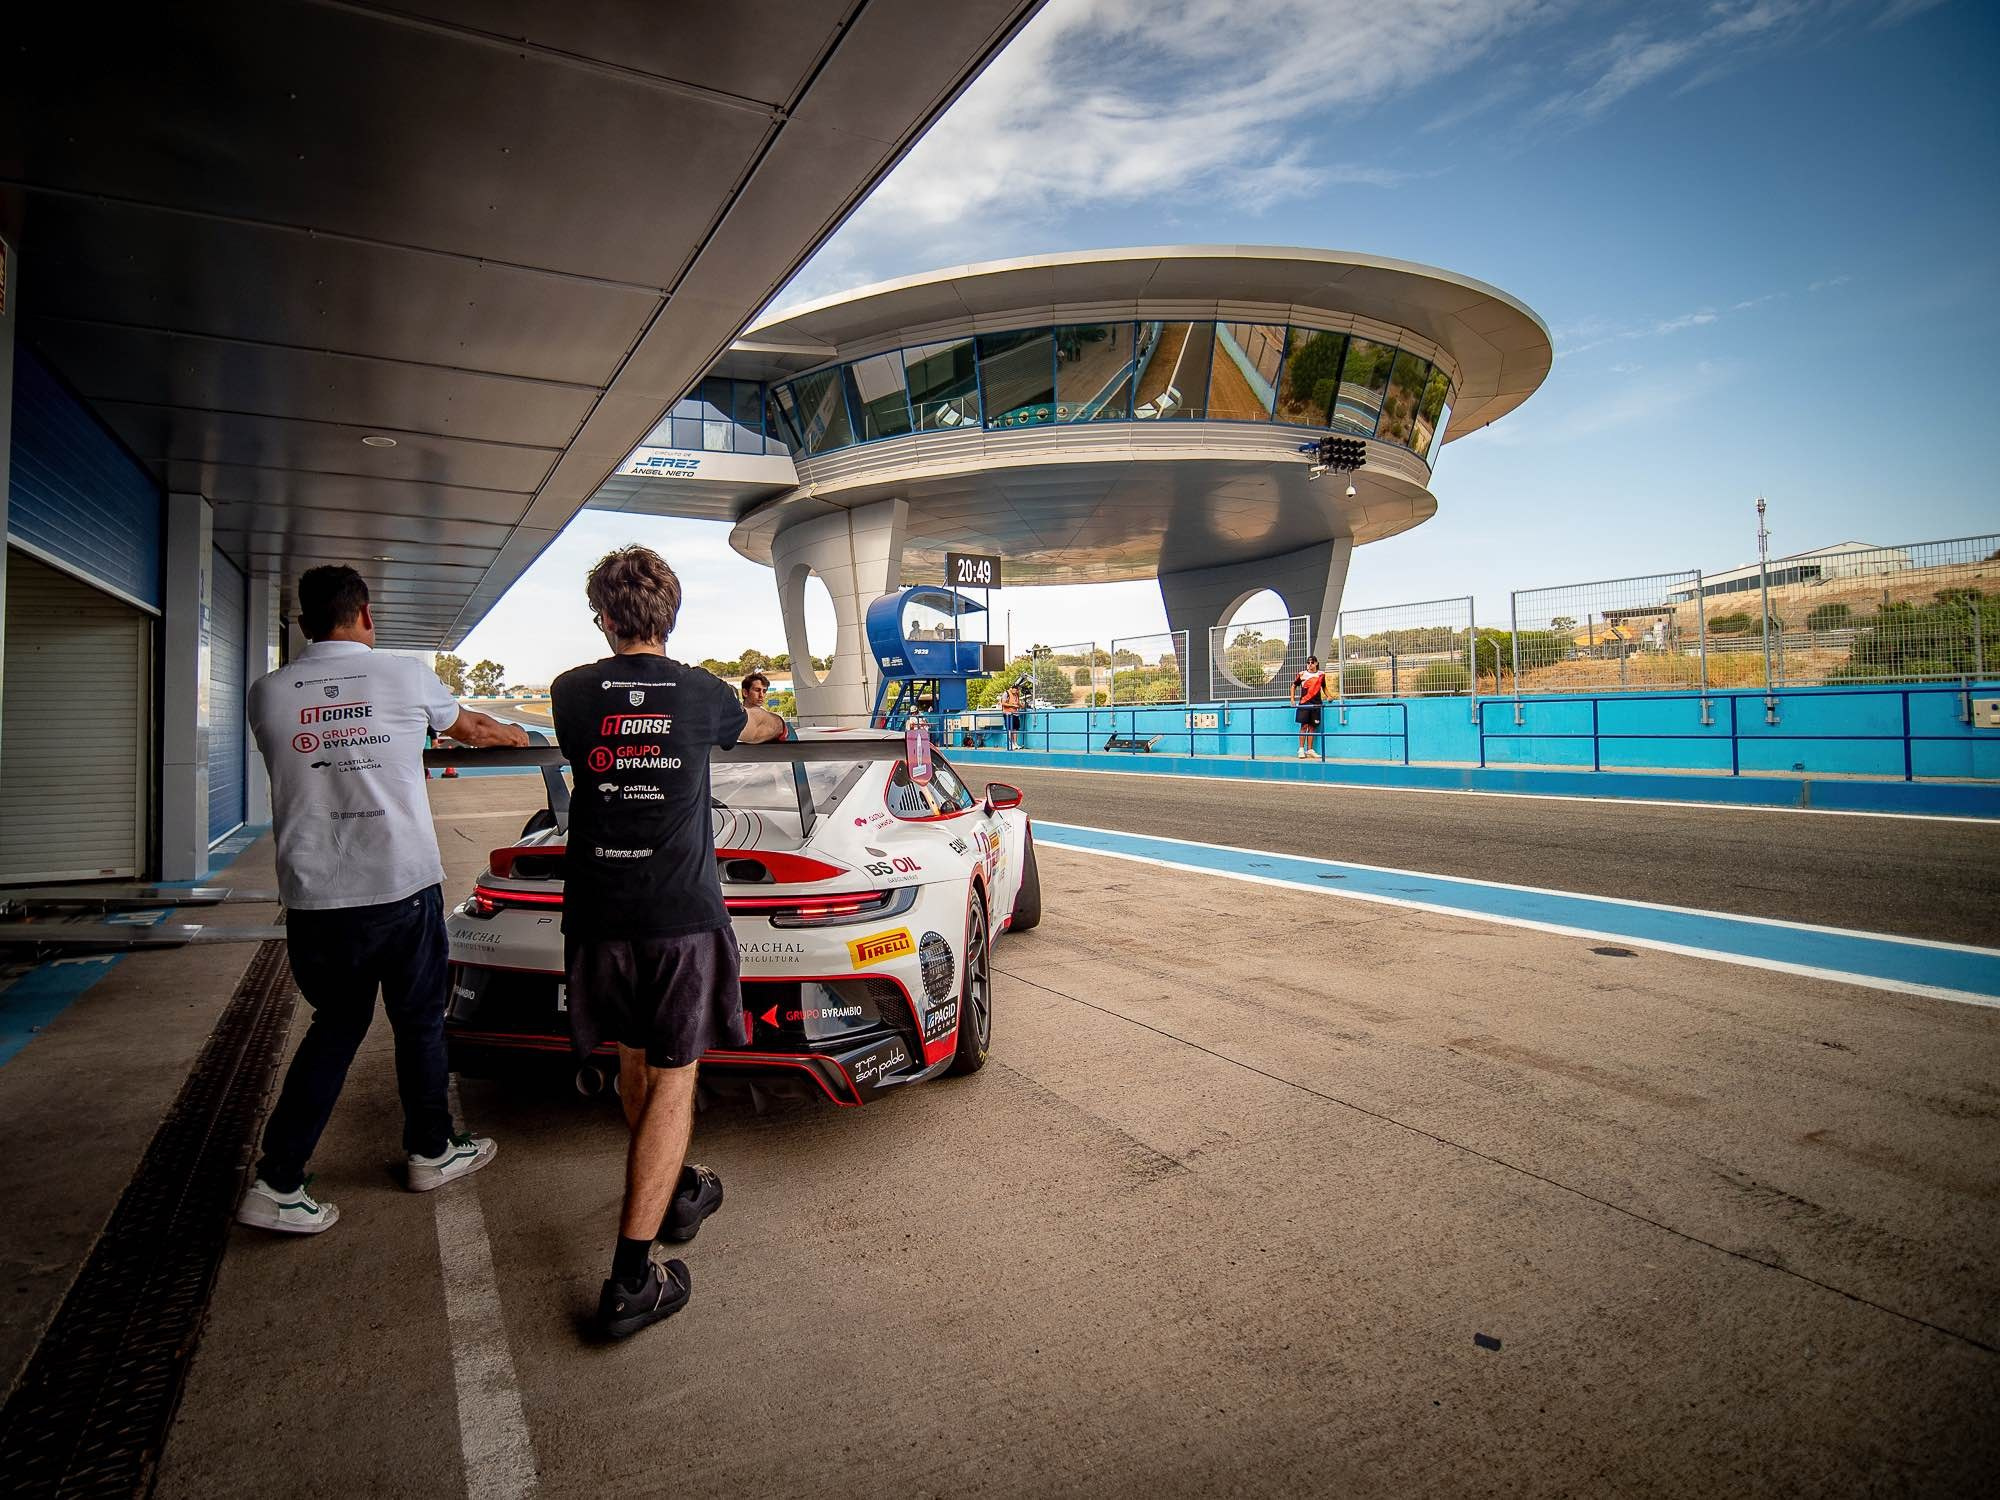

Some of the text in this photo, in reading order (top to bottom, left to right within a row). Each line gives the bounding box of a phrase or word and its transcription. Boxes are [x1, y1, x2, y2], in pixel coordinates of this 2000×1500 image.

[636, 457, 701, 469] JEREZ
[631, 467, 695, 478] ÁNGEL NIETO
[957, 558, 991, 584] 20:49
[322, 727, 367, 740] GRUPO
[616, 745, 661, 757] GRUPO
[350, 763, 382, 773] MANCHA
[864, 856, 922, 877] BS OIL
[739, 943, 805, 953] NACHAL
[856, 933, 910, 961] PIRELLI
[740, 955, 800, 963] RICULTURA
[786, 1009, 819, 1021] GRUPO
[934, 1002, 956, 1026] PAGID
[926, 1017, 956, 1038] RACING
[855, 1055, 877, 1072] grupo
[856, 1067, 878, 1083] san
